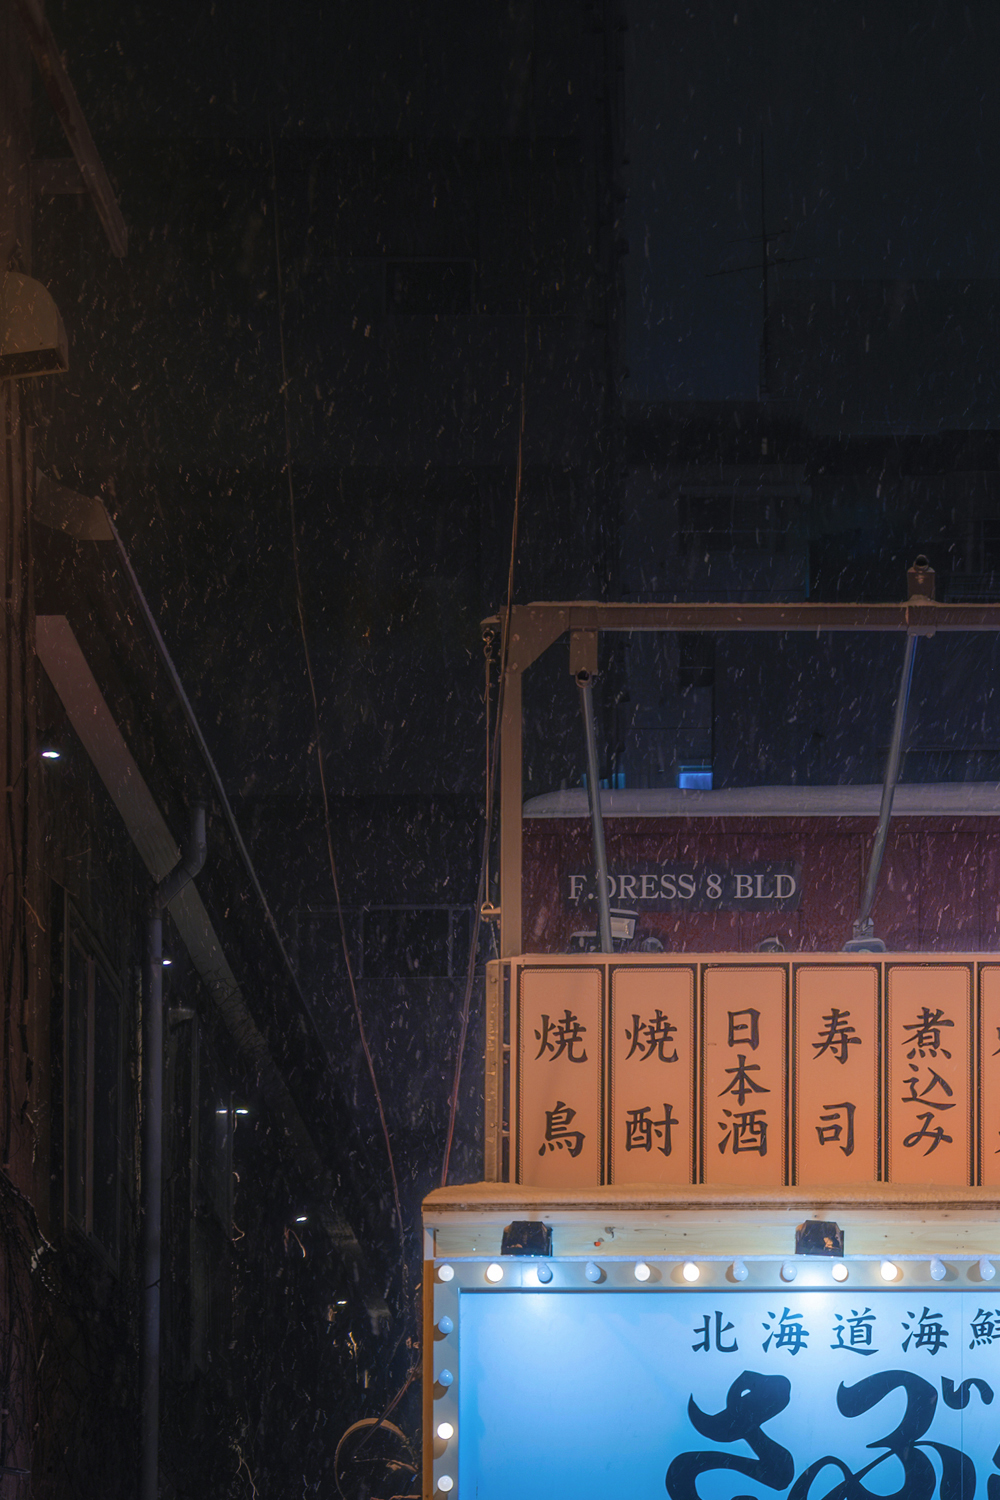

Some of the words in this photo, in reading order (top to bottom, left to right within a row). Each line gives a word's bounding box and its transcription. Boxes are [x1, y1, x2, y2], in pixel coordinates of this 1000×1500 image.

[705, 873, 723, 900] 8
[733, 874, 797, 899] BLD
[535, 1010, 587, 1157] 焼鳥
[625, 1010, 679, 1156] 焼酎
[718, 1008, 770, 1156] 日本酒
[812, 1008, 861, 1156] 寿司
[902, 1007, 956, 1156] 煮込み
